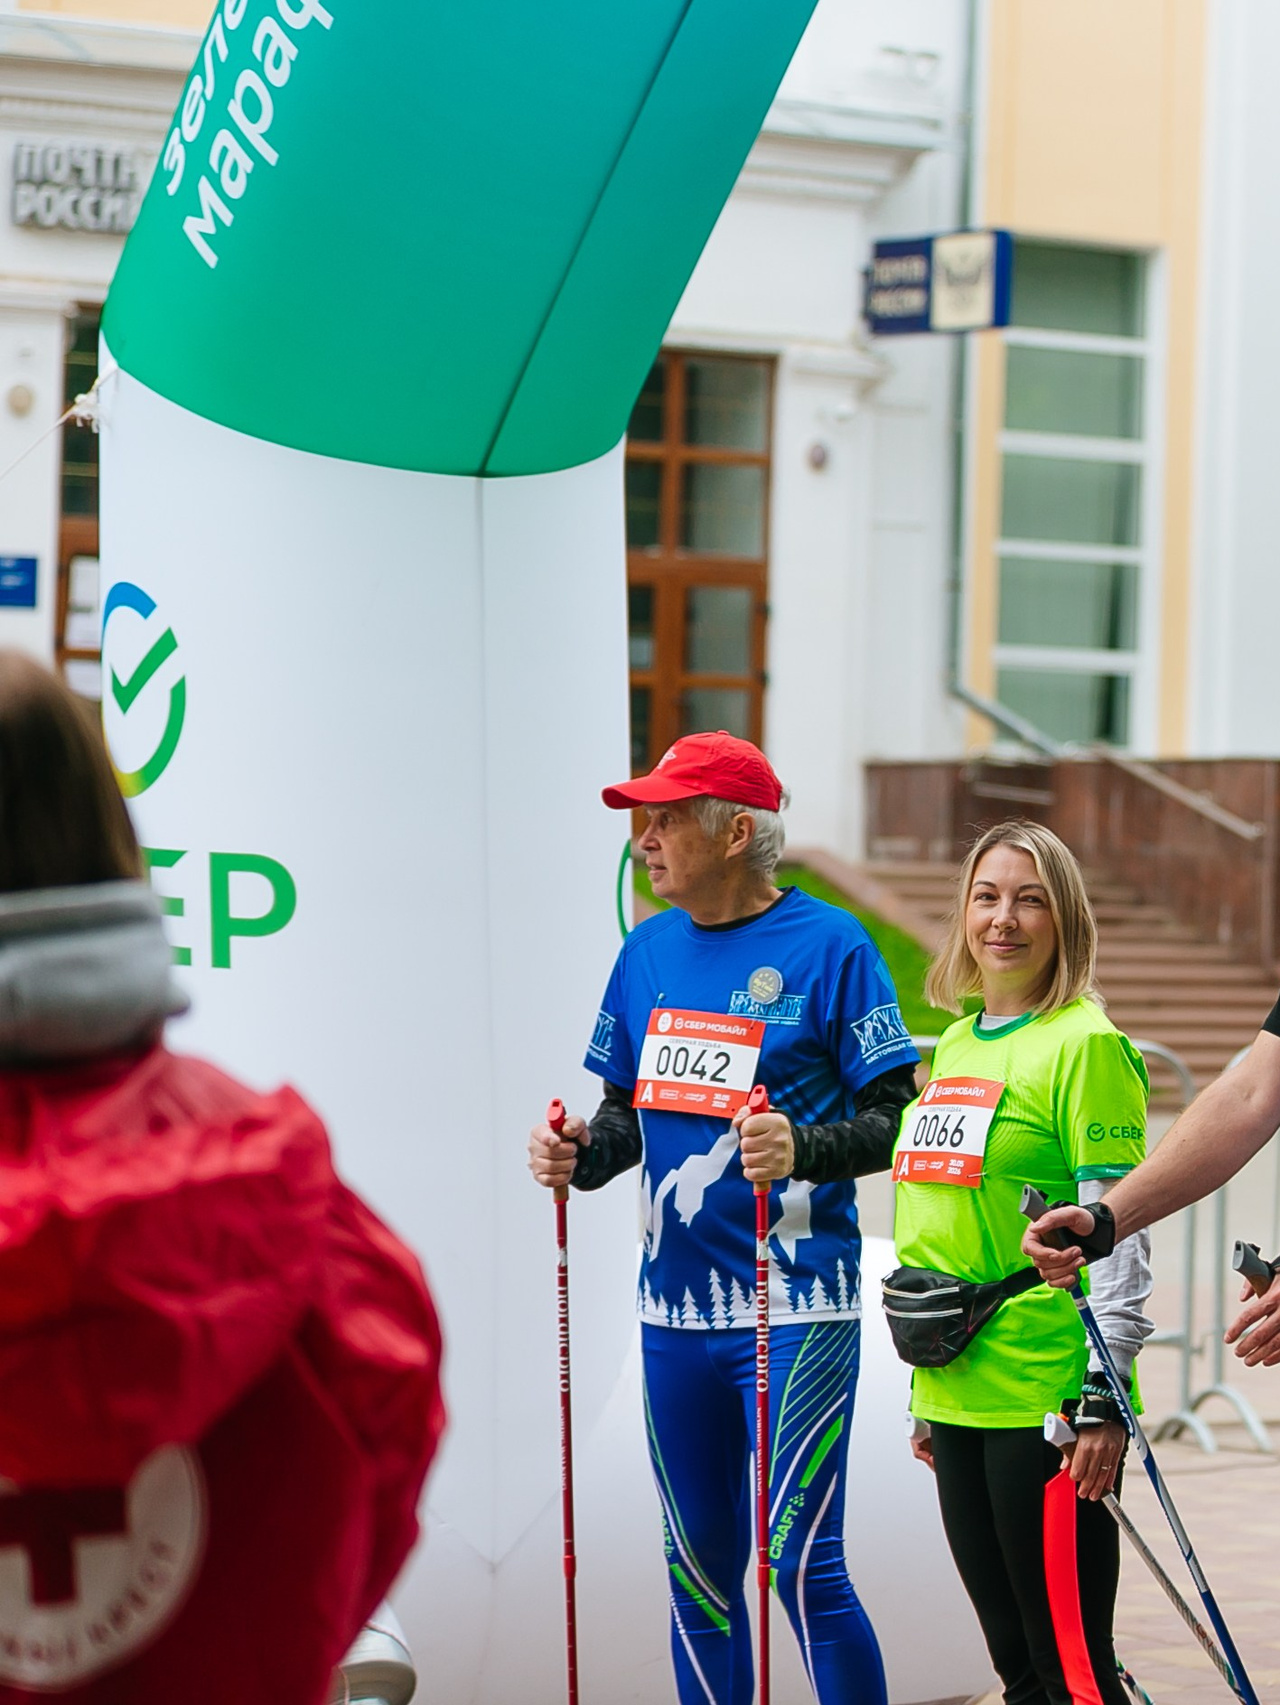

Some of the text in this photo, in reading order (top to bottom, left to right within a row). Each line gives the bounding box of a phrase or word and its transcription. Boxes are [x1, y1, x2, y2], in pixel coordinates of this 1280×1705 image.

[684, 1020, 747, 1036] СБЕР МОБАЙЛ
[656, 1045, 731, 1083] 0042
[955, 1086, 986, 1097] МОБАЙЛ
[913, 1114, 966, 1148] 0066
[1110, 1126, 1143, 1140] СБЕР
[756, 1280, 770, 1392] nordicpro
[769, 1504, 799, 1560] CRAFT
